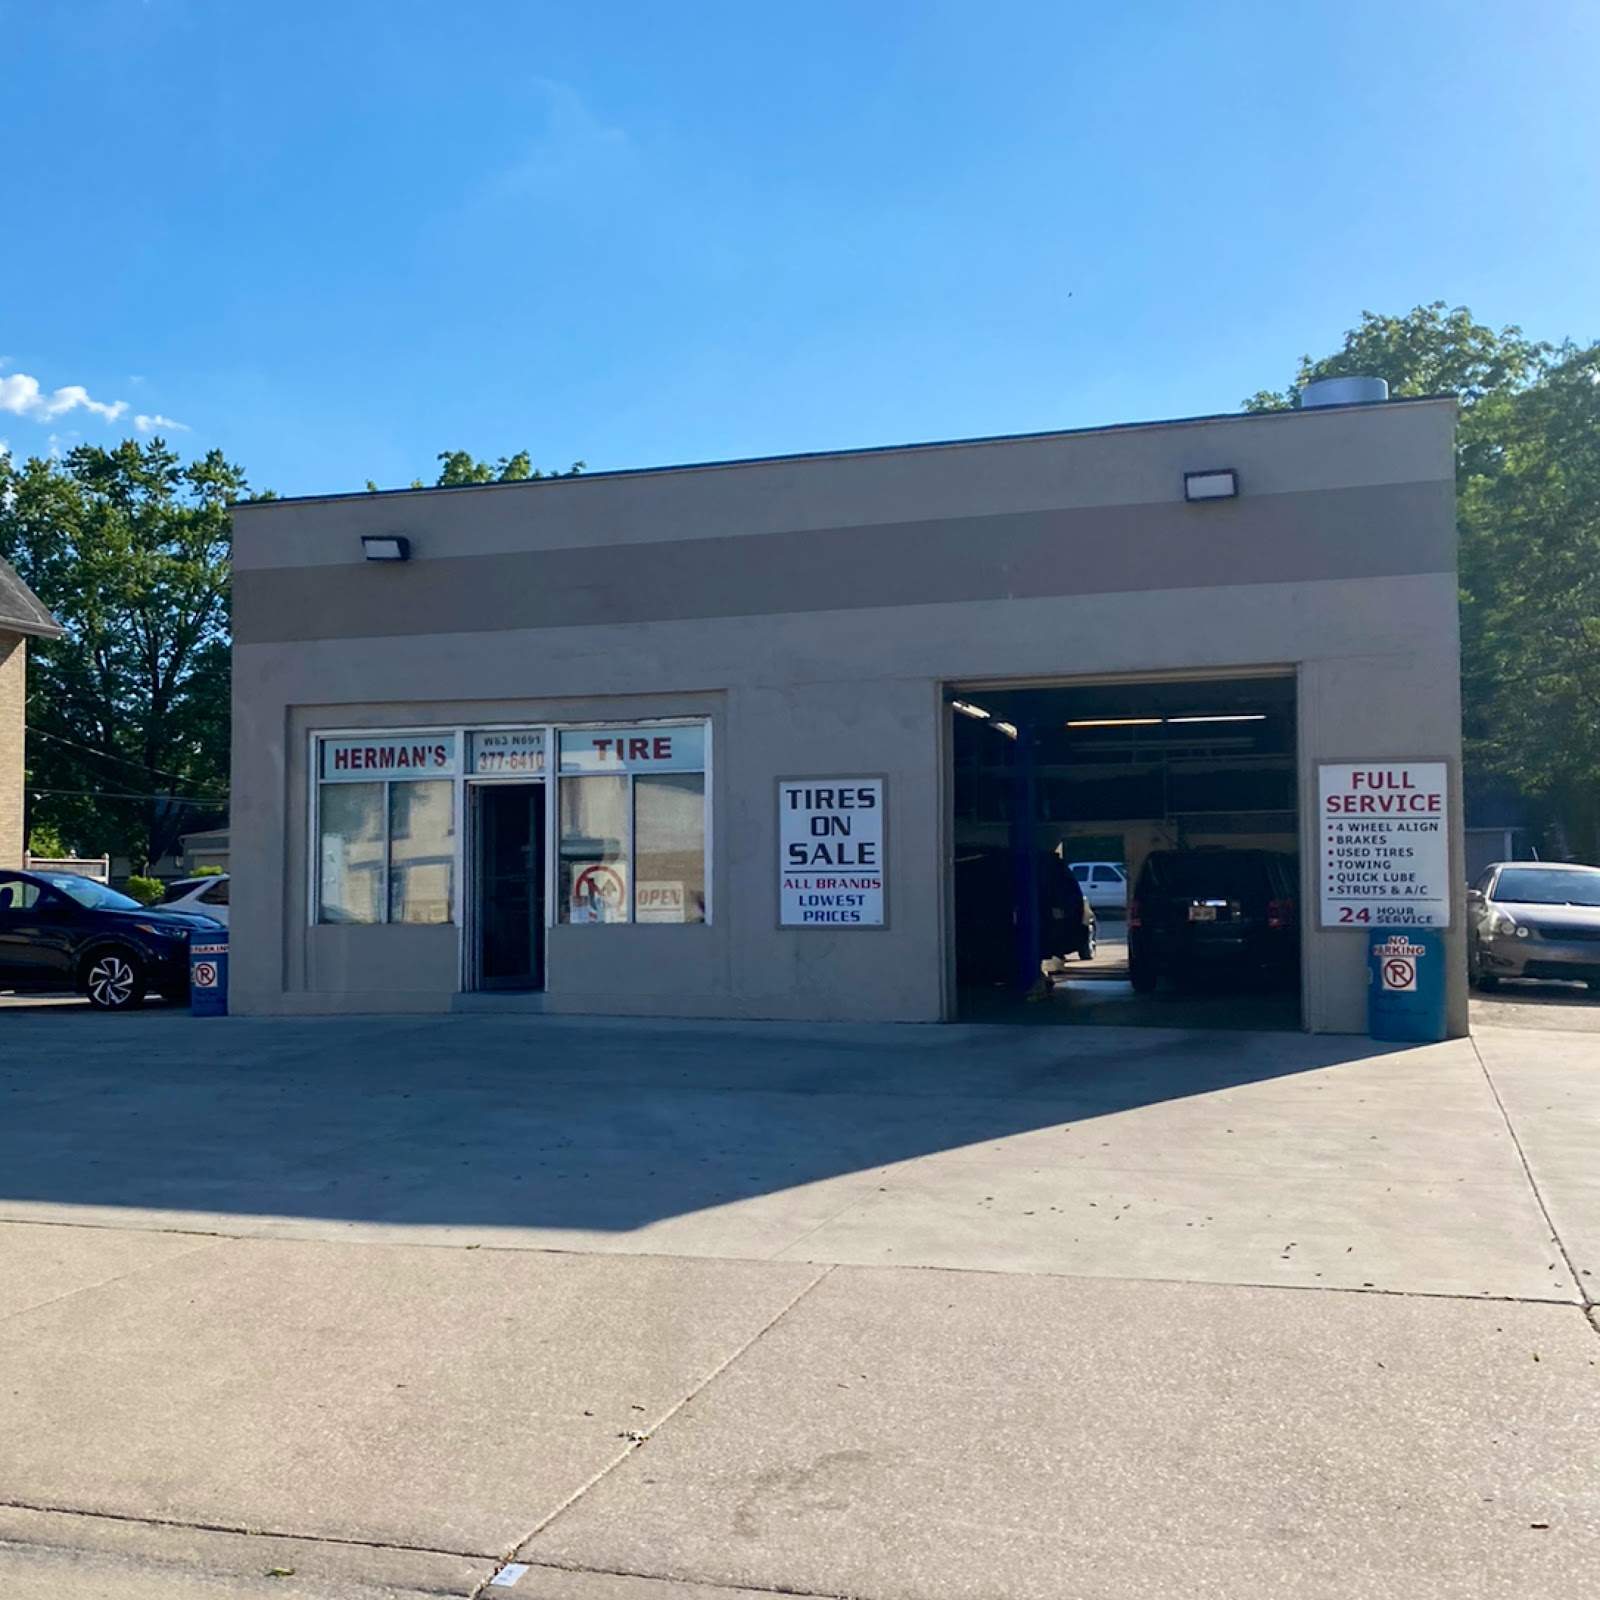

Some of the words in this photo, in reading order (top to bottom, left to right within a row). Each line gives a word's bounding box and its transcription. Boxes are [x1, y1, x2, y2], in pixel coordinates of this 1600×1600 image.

[592, 737, 673, 761] TIRE
[334, 744, 447, 770] HERMAN'S
[480, 750, 545, 769] 377-6410
[1352, 771, 1416, 790] FULL
[785, 788, 876, 810] TIRES
[1326, 794, 1442, 813] SERVICE
[811, 815, 851, 837] ON
[1336, 823, 1344, 832] 4
[1348, 823, 1393, 832] WHEEL
[1397, 822, 1439, 832] ALIGN
[1336, 835, 1387, 845] BRAKES
[789, 842, 876, 866] SALE
[1336, 847, 1371, 857] USED
[1375, 847, 1414, 857] TIRES
[1337, 860, 1392, 870] TOWING
[784, 878, 811, 889] ALL
[815, 877, 882, 890] BRANDS
[1337, 872, 1379, 883] QUICK
[1383, 872, 1417, 882] LUBE
[638, 888, 681, 905] OPEN
[1337, 885, 1387, 895] STRUTS
[1391, 885, 1400, 895] &
[1404, 885, 1429, 896] A/C
[798, 894, 866, 907] LOWEST
[803, 910, 861, 922] PRICES
[1339, 907, 1371, 924] 24
[1377, 906, 1415, 916] HOUR
[1376, 915, 1433, 925] SERVICE
[1390, 936, 1408, 945] NO
